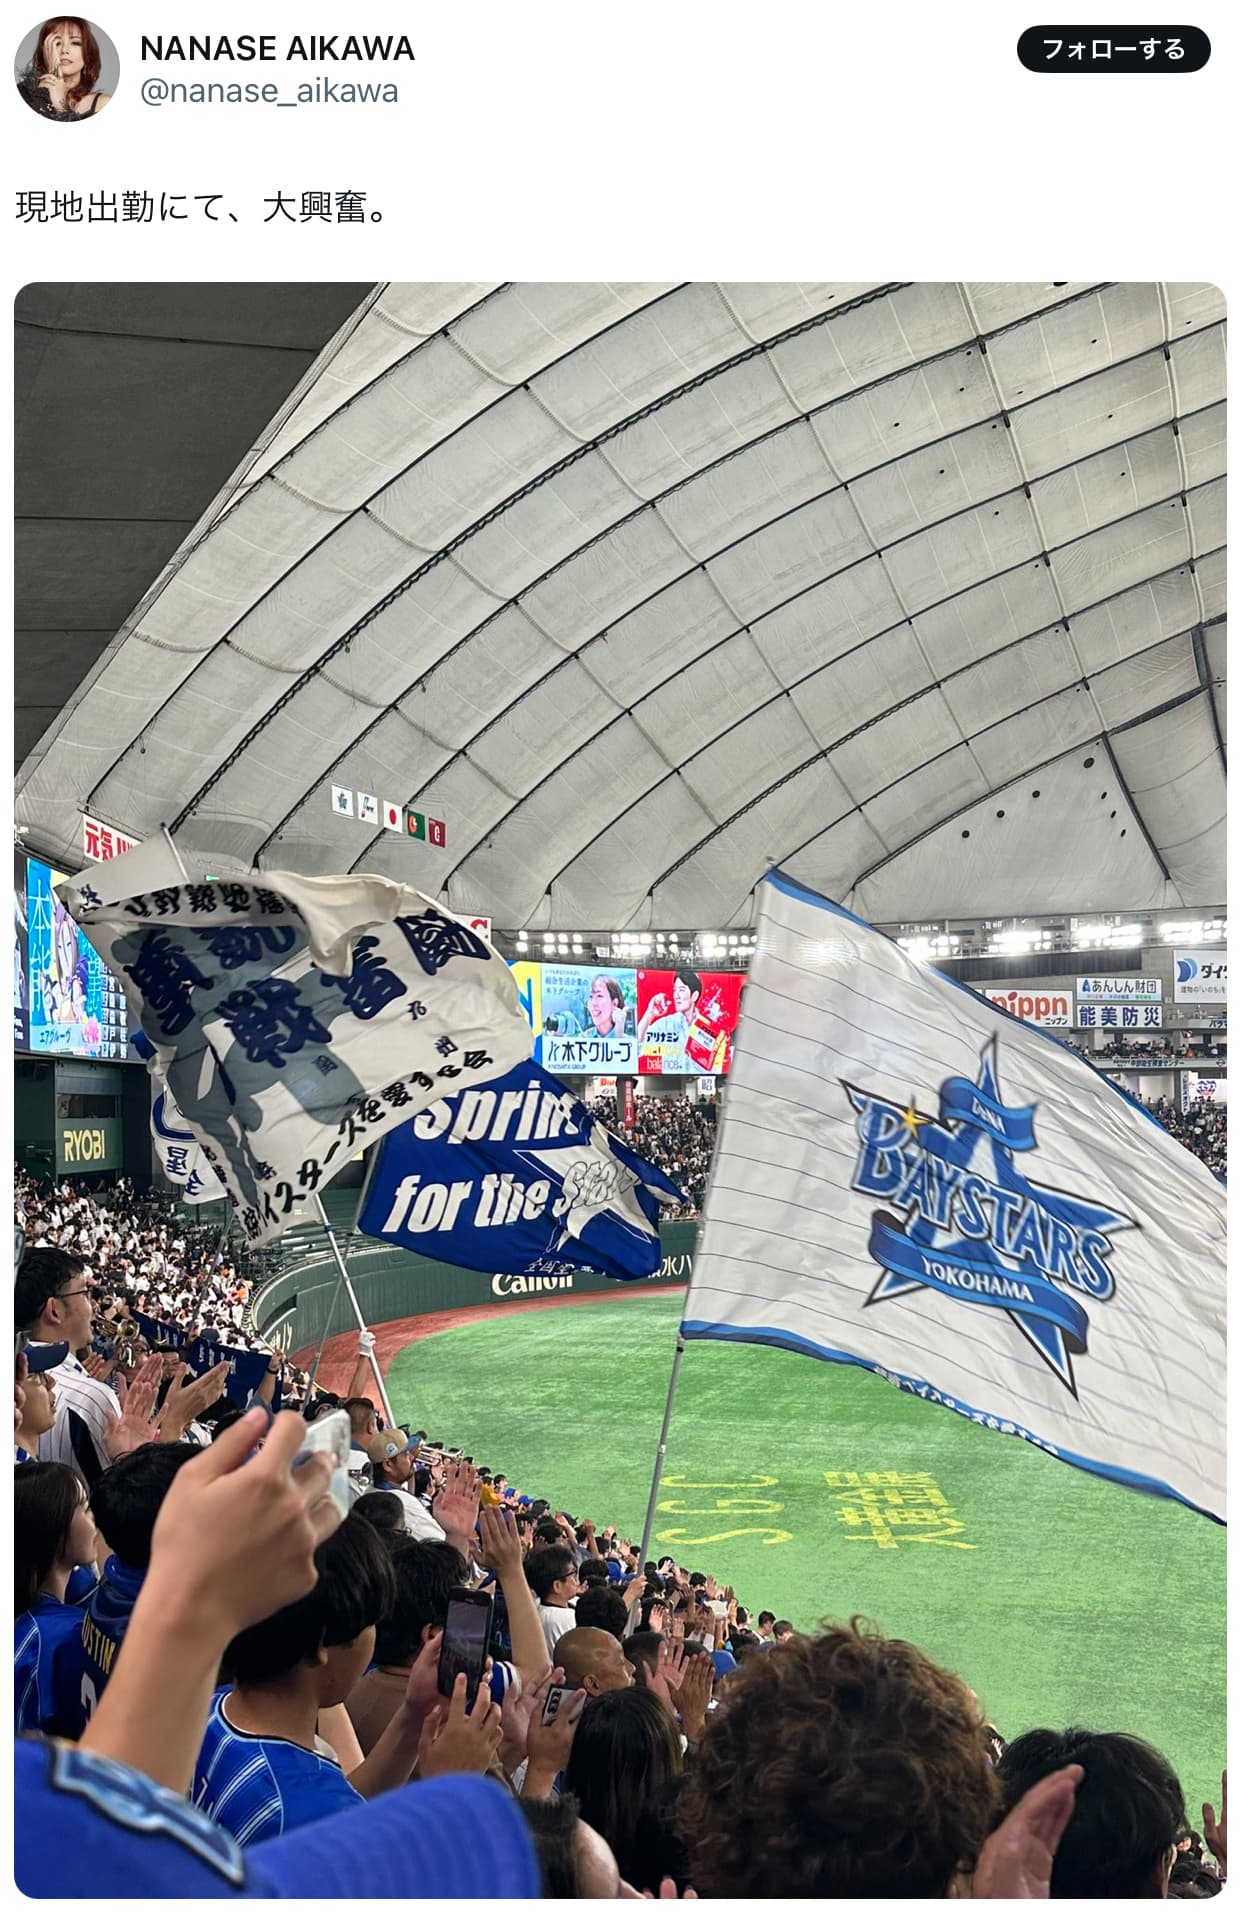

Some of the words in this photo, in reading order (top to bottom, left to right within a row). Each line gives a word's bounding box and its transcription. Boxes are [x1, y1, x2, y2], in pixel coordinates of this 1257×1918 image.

[28, 880, 51, 1014] 本能
[1092, 979, 1157, 994] あんしん財団
[646, 1032, 679, 1043] アリナミン
[1080, 1006, 1160, 1027] 能美防災
[561, 1040, 633, 1063] 木下グループ
[63, 1128, 106, 1162] RYOBI
[381, 1174, 471, 1234] for
[474, 1173, 551, 1228] the
[853, 1098, 1118, 1302] BAYSTARS
[922, 1256, 1035, 1303] YOKOHAMA
[655, 1474, 794, 1546] SGC
[81, 1608, 117, 1675] USTIN
